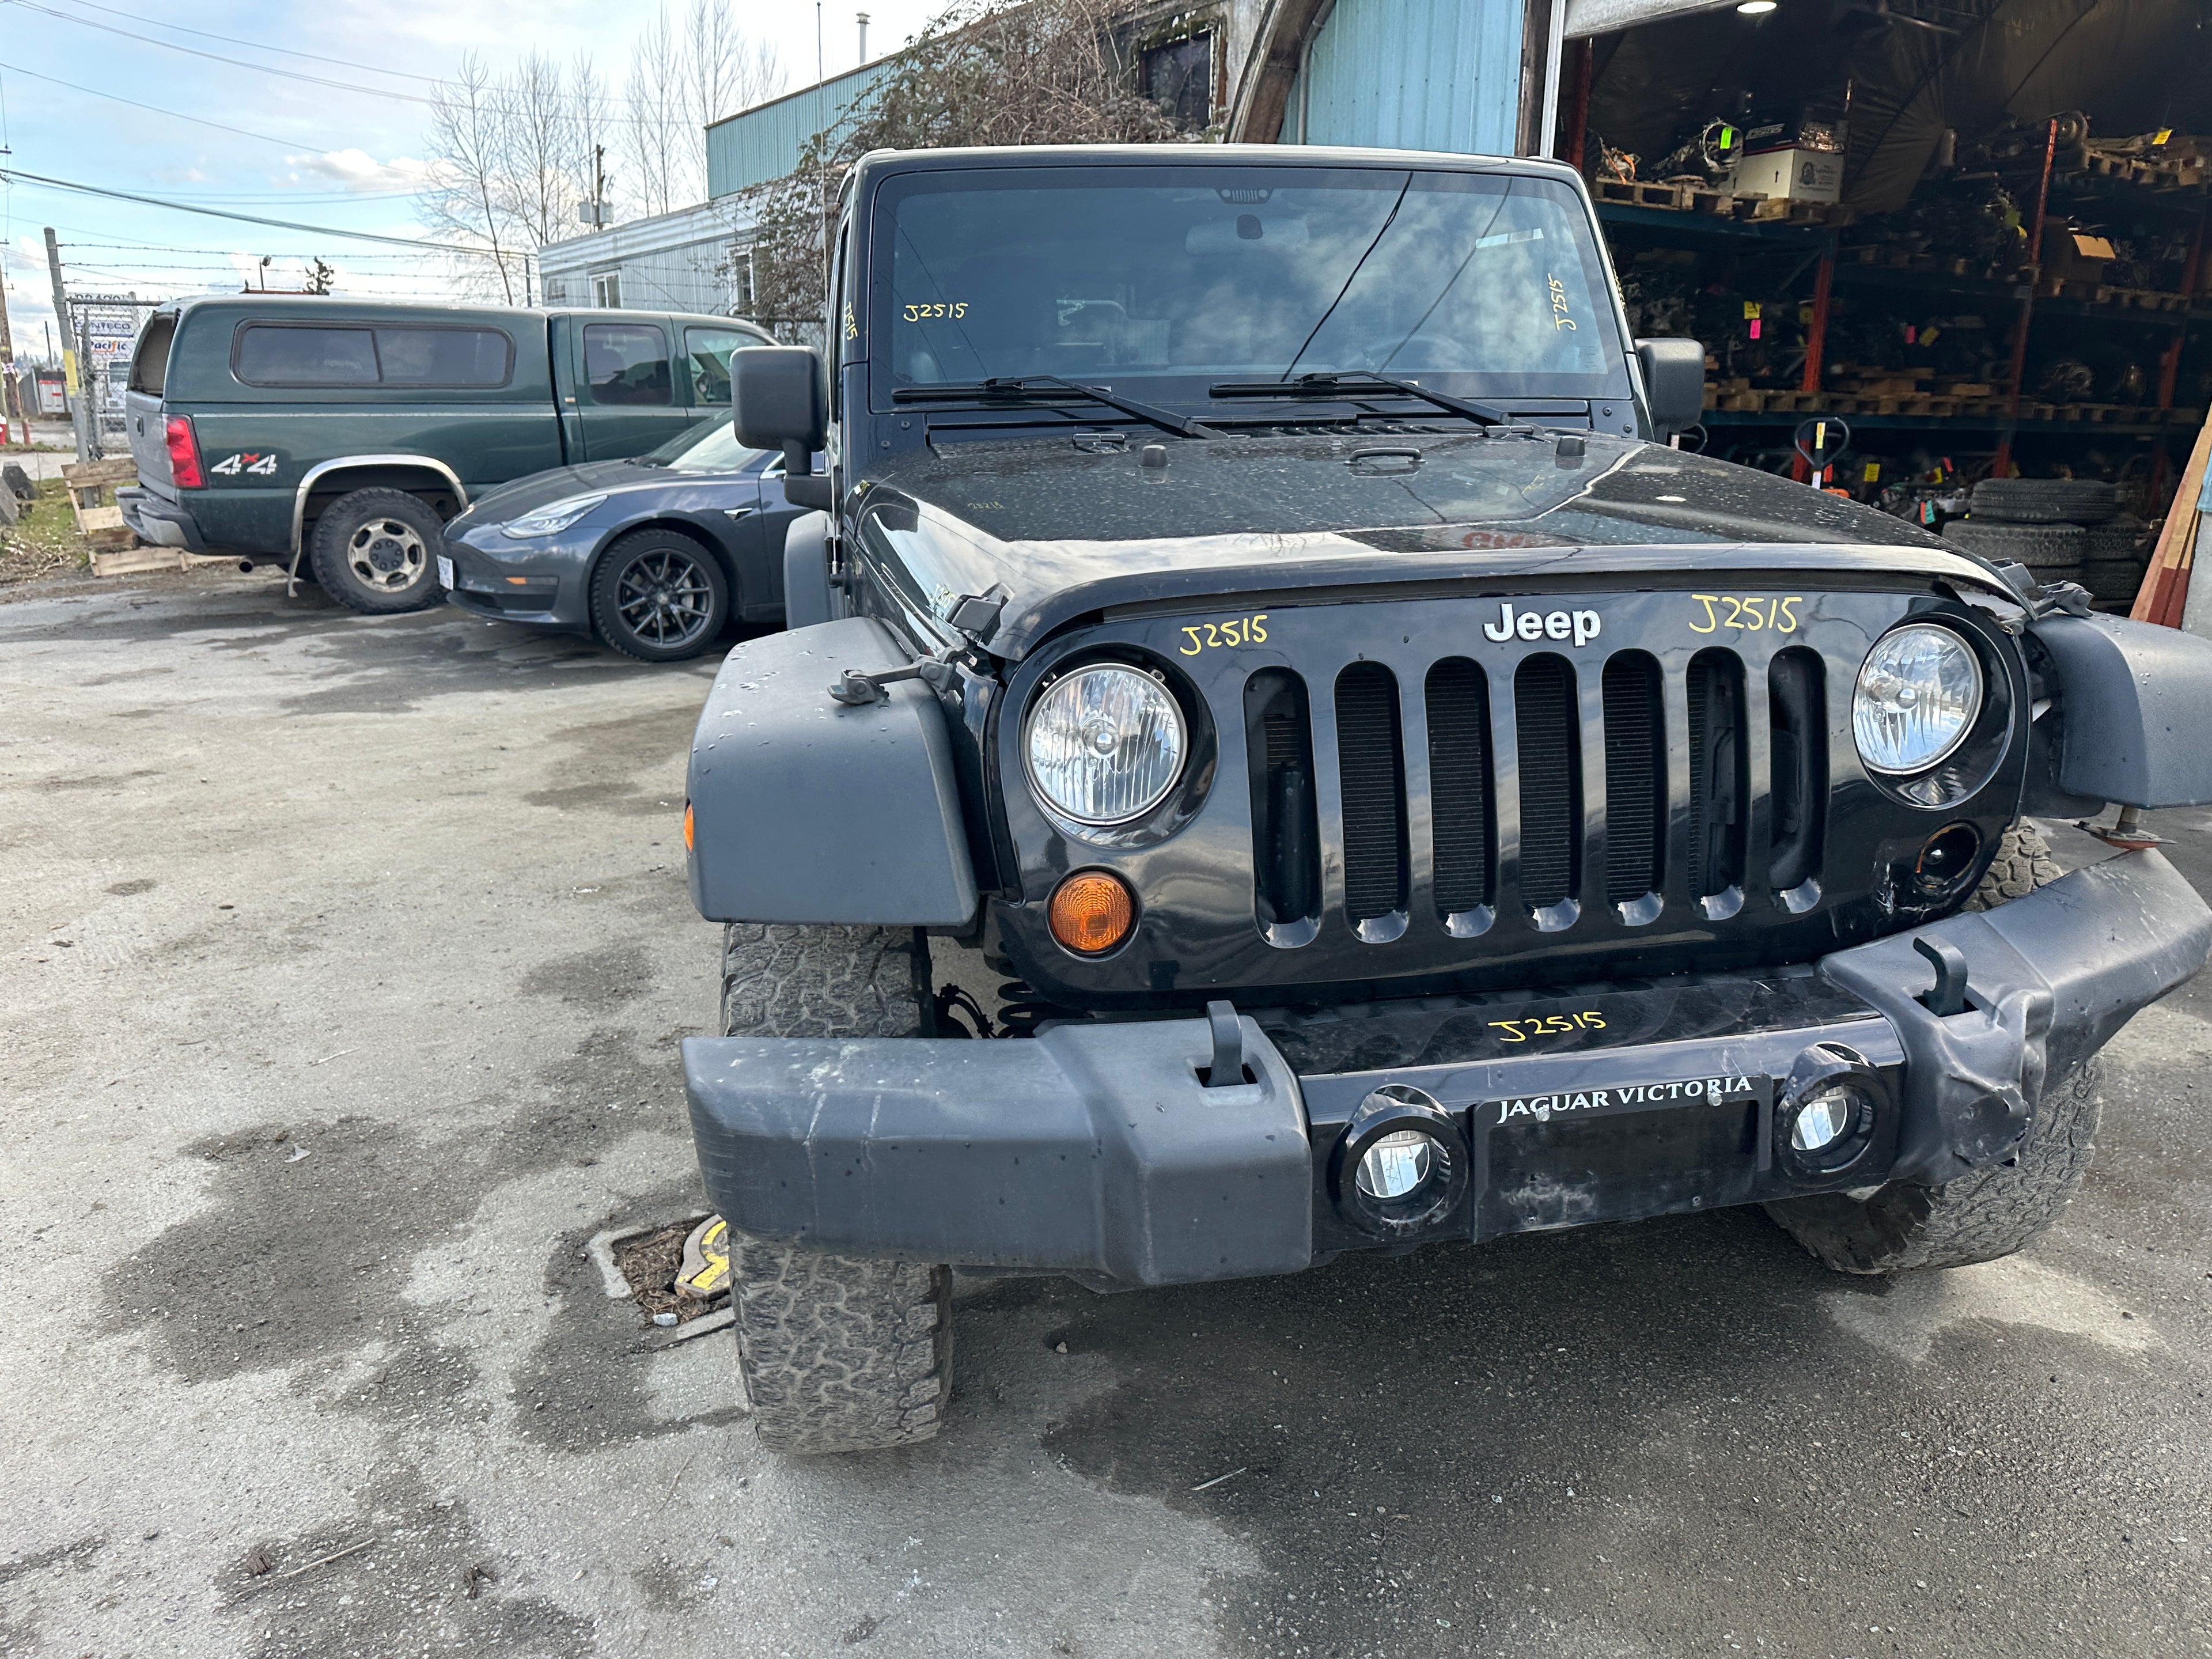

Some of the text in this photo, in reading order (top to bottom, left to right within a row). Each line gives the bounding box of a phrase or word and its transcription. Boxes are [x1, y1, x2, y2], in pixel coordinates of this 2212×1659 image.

[903, 302, 969, 323] J2515
[1548, 272, 1577, 331] J2515
[211, 453, 276, 475] 4x4
[1483, 603, 1601, 647] Jeep
[1689, 594, 1802, 633] J2515
[1180, 614, 1268, 656] J2515
[1488, 1011, 1607, 1042] J2515
[1497, 1076, 1753, 1124] JAGUAR VICTORIA
